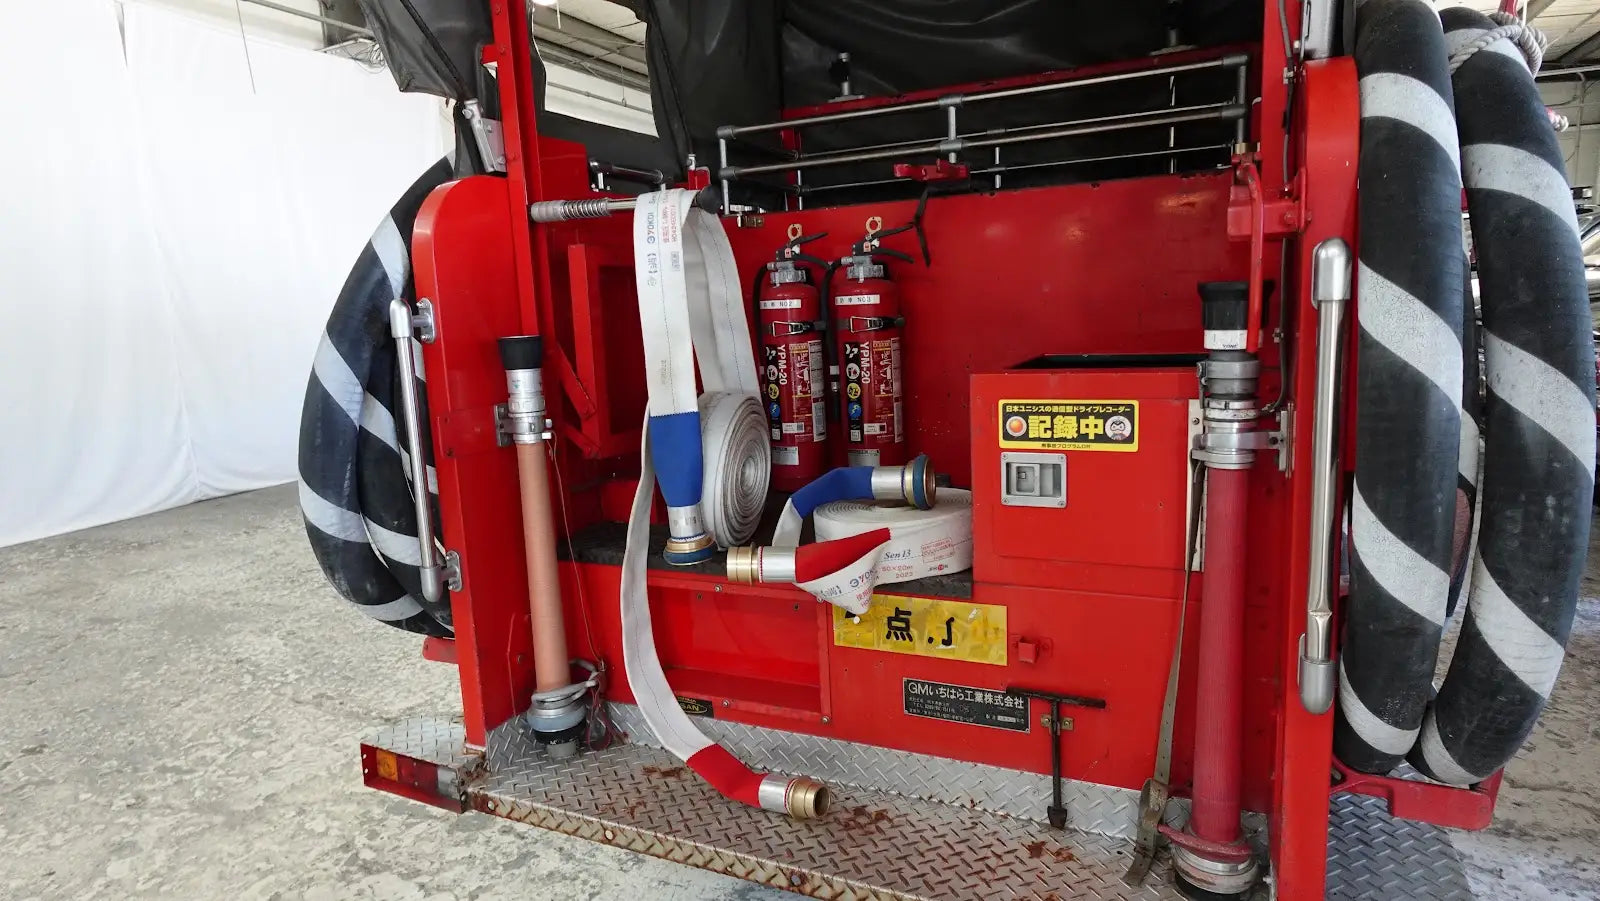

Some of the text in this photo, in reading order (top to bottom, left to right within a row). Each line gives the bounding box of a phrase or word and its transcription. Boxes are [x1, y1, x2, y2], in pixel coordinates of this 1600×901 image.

[777, 344, 788, 385] YPM-20
[860, 341, 871, 384] YPM-20
[1027, 415, 1104, 439] 記録中
[908, 682, 1024, 709] GMいちはら工業株式会社
